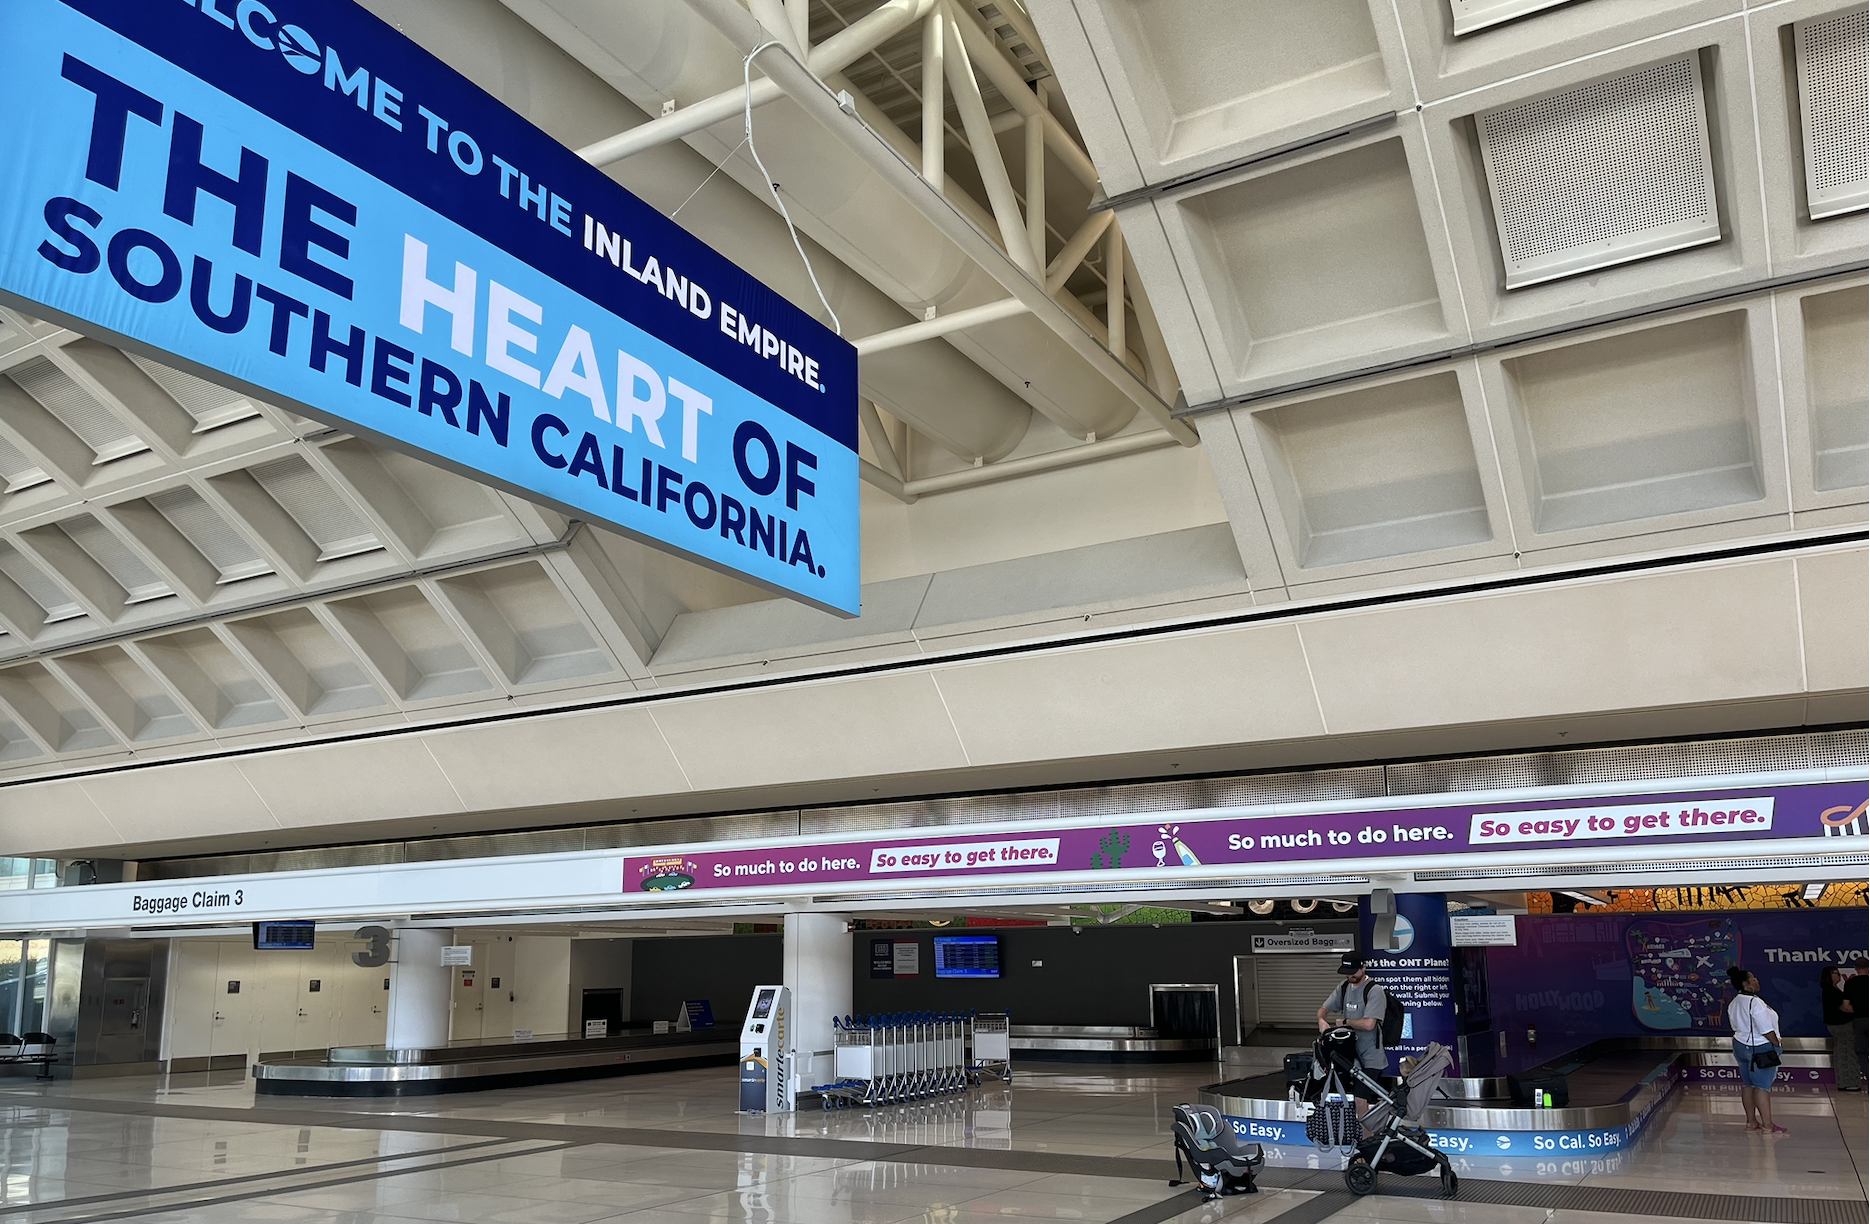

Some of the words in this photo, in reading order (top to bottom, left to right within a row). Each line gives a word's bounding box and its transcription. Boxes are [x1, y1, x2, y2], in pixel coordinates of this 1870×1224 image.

[183, 0, 404, 133] LCOME
[418, 104, 484, 176] TO
[492, 153, 573, 238] THE
[583, 213, 712, 320] INLAND
[720, 301, 826, 394] EMPIRE.
[60, 51, 357, 301] THE
[399, 232, 713, 465] HEART
[732, 419, 818, 512] OF
[37, 196, 510, 448] SOUTHERN
[530, 413, 826, 579] CALIFORNIA.
[1479, 820, 1511, 837] So
[1517, 818, 1581, 837] easy
[1587, 815, 1616, 832] to
[1623, 811, 1670, 834] get
[1678, 808, 1766, 827] there.
[1228, 833, 1255, 850] So
[1260, 829, 1322, 849] much
[1327, 829, 1352, 845] to
[1357, 826, 1387, 844] do
[1392, 824, 1454, 842] here.
[713, 863, 731, 877] So
[734, 860, 776, 876] much
[779, 860, 795, 873] to
[798, 858, 817, 872] do
[821, 856, 861, 871] here.
[876, 853, 897, 867] So
[901, 852, 940, 868] easy
[944, 851, 962, 864] to
[966, 848, 996, 866] get
[1001, 846, 1054, 861] there.
[133, 895, 188, 914] Baggage
[192, 891, 230, 908] Claim
[234, 889, 244, 906] 3
[352, 926, 391, 967] 3
[1267, 938, 1310, 946] Oversized
[1379, 958, 1397, 967] the
[1399, 958, 1421, 967] ONT
[1764, 947, 1832, 963] Thank
[1386, 976, 1401, 984] spot
[1402, 975, 1422, 983] them
[1414, 984, 1431, 992] right
[1515, 989, 1605, 1012] HOLLYWOOD
[1699, 1068, 1714, 1078] So
[1717, 1068, 1740, 1078] Cal.
[1777, 1071, 1793, 1081] sy.
[1233, 1120, 1247, 1134] So
[1249, 1122, 1286, 1141] Easy.
[1534, 1135, 1555, 1150] So
[1559, 1134, 1586, 1149] Cal.
[1588, 1133, 1602, 1148] So
[1603, 1132, 1621, 1147] Easy.
[1428, 1132, 1474, 1152] Easy.
